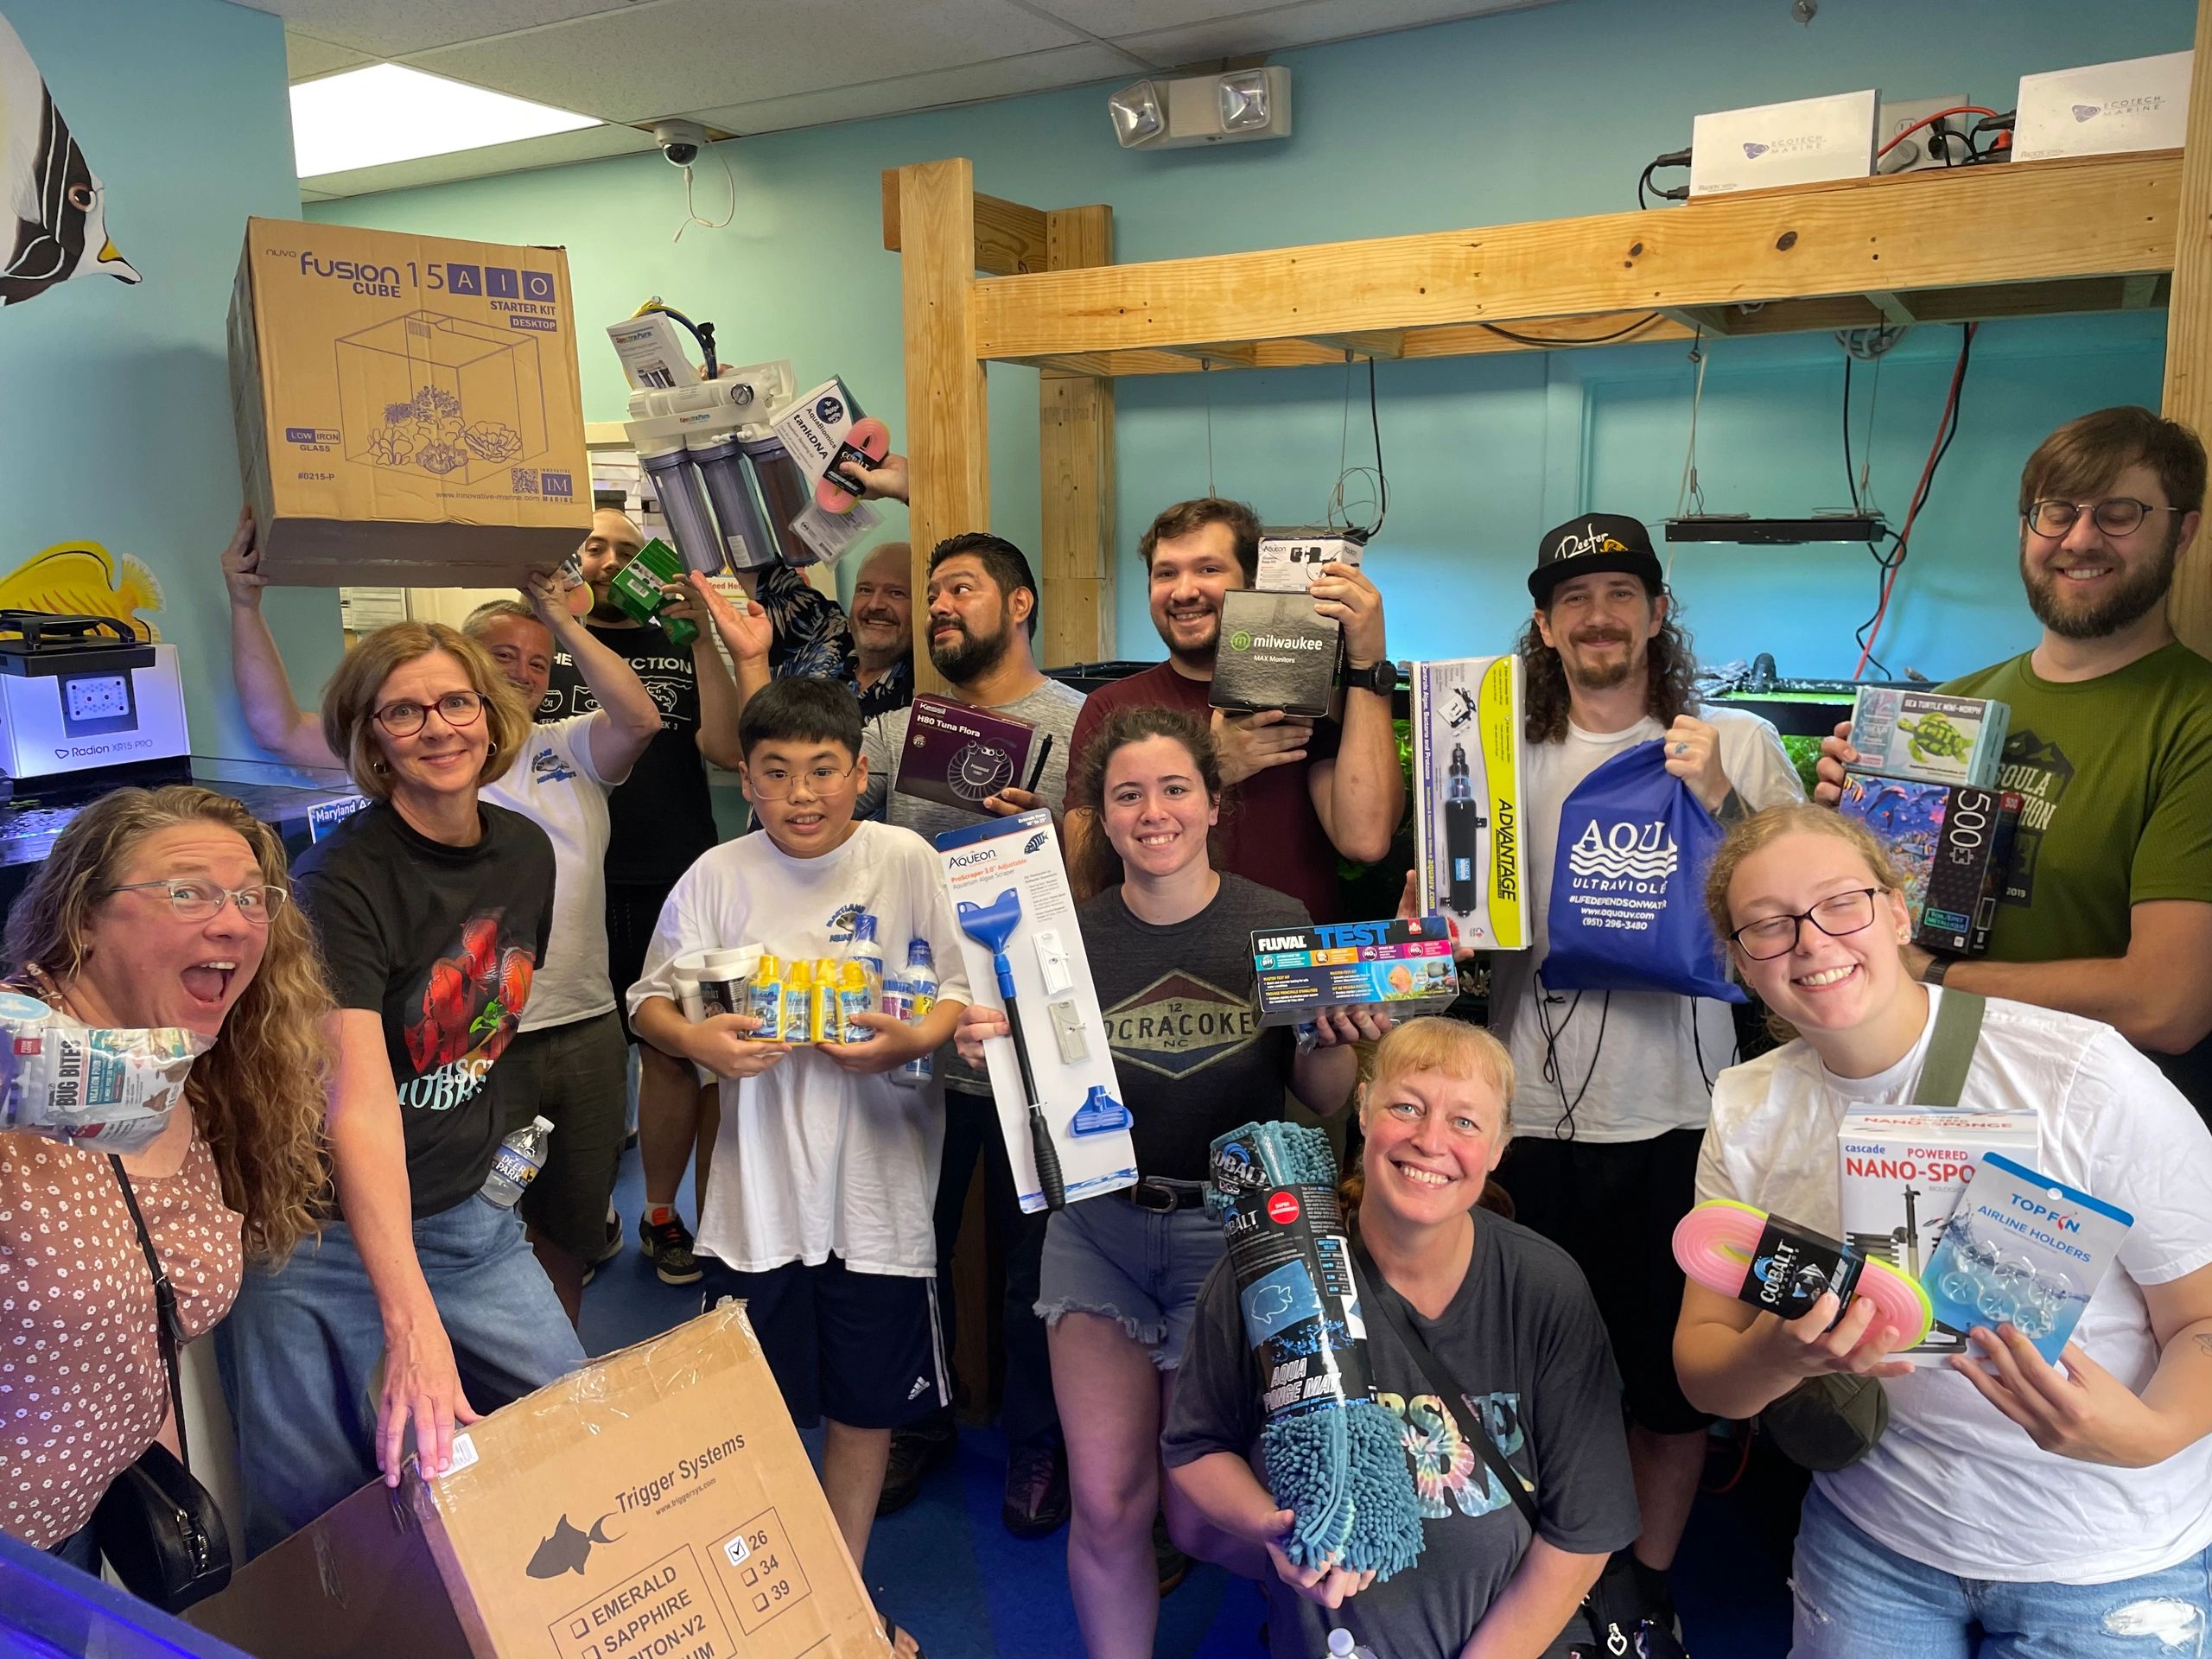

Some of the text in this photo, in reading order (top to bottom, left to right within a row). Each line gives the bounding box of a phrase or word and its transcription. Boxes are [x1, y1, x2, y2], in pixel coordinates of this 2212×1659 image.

[2103, 104, 2160, 117] MARINE
[2104, 96, 2161, 108] ECOTECH
[1771, 136, 1822, 146] ECOTECH
[1771, 143, 1821, 154] MARINE
[301, 251, 400, 284] fusion
[406, 262, 443, 289] 15
[353, 282, 401, 298] CUBE
[491, 301, 556, 315] STARTER KIT
[512, 318, 556, 329] DESKTOP
[290, 431, 339, 442] LOW IRON
[793, 414, 829, 460] tankDNA
[806, 408, 836, 449] AquaBiomics
[1254, 634, 1323, 650] milwaukee
[554, 652, 572, 666] HE
[920, 702, 946, 715] Kessil
[1904, 699, 1916, 708] SEA
[1918, 701, 1942, 711] TURTLE
[917, 715, 981, 737] H80 Tuna Flora
[72, 739, 153, 758] Radion XR15 PRO
[316, 802, 355, 822] Maryland
[1950, 790, 1992, 848] 500
[1579, 819, 1676, 856] AQU
[1498, 798, 1516, 902] ADVANTAGE
[950, 869, 983, 883] ProScraper
[998, 858, 1027, 871] Adjustable
[952, 869, 1014, 890] Aquarium Algae Scraper
[1580, 907, 1655, 920] www.aquauv.com
[1583, 918, 1647, 931] (951) 296-3480
[1258, 923, 1389, 951] FLUVAL TEST
[1169, 1003, 1182, 1012] 12
[1104, 1012, 1253, 1040] OCRACOKE
[56, 1040, 82, 1106] BUG BITES
[1845, 1144, 1885, 1154] cascade
[1907, 1147, 1967, 1160] POWERED
[495, 1162, 522, 1183] PARK
[501, 1154, 526, 1175] DEER
[2012, 1192, 2046, 1215] TOP
[1224, 1210, 1259, 1237] OBALT
[1978, 1205, 2092, 1262] AIRLINE HOLDERS
[1760, 1239, 1794, 1303] COBALT
[1270, 1357, 1307, 1388] AQUA
[1262, 1380, 1302, 1414] PONGE
[1303, 1372, 1342, 1399] MAT
[615, 1434, 746, 1514] Trigger Systems
[655, 1477, 717, 1516] www.triggersys.com
[748, 1530, 768, 1552] 26
[760, 1554, 779, 1575] 34
[591, 1566, 677, 1627] EMERALD
[771, 1580, 790, 1601] 39
[604, 1589, 692, 1653] SAPPHIRE
